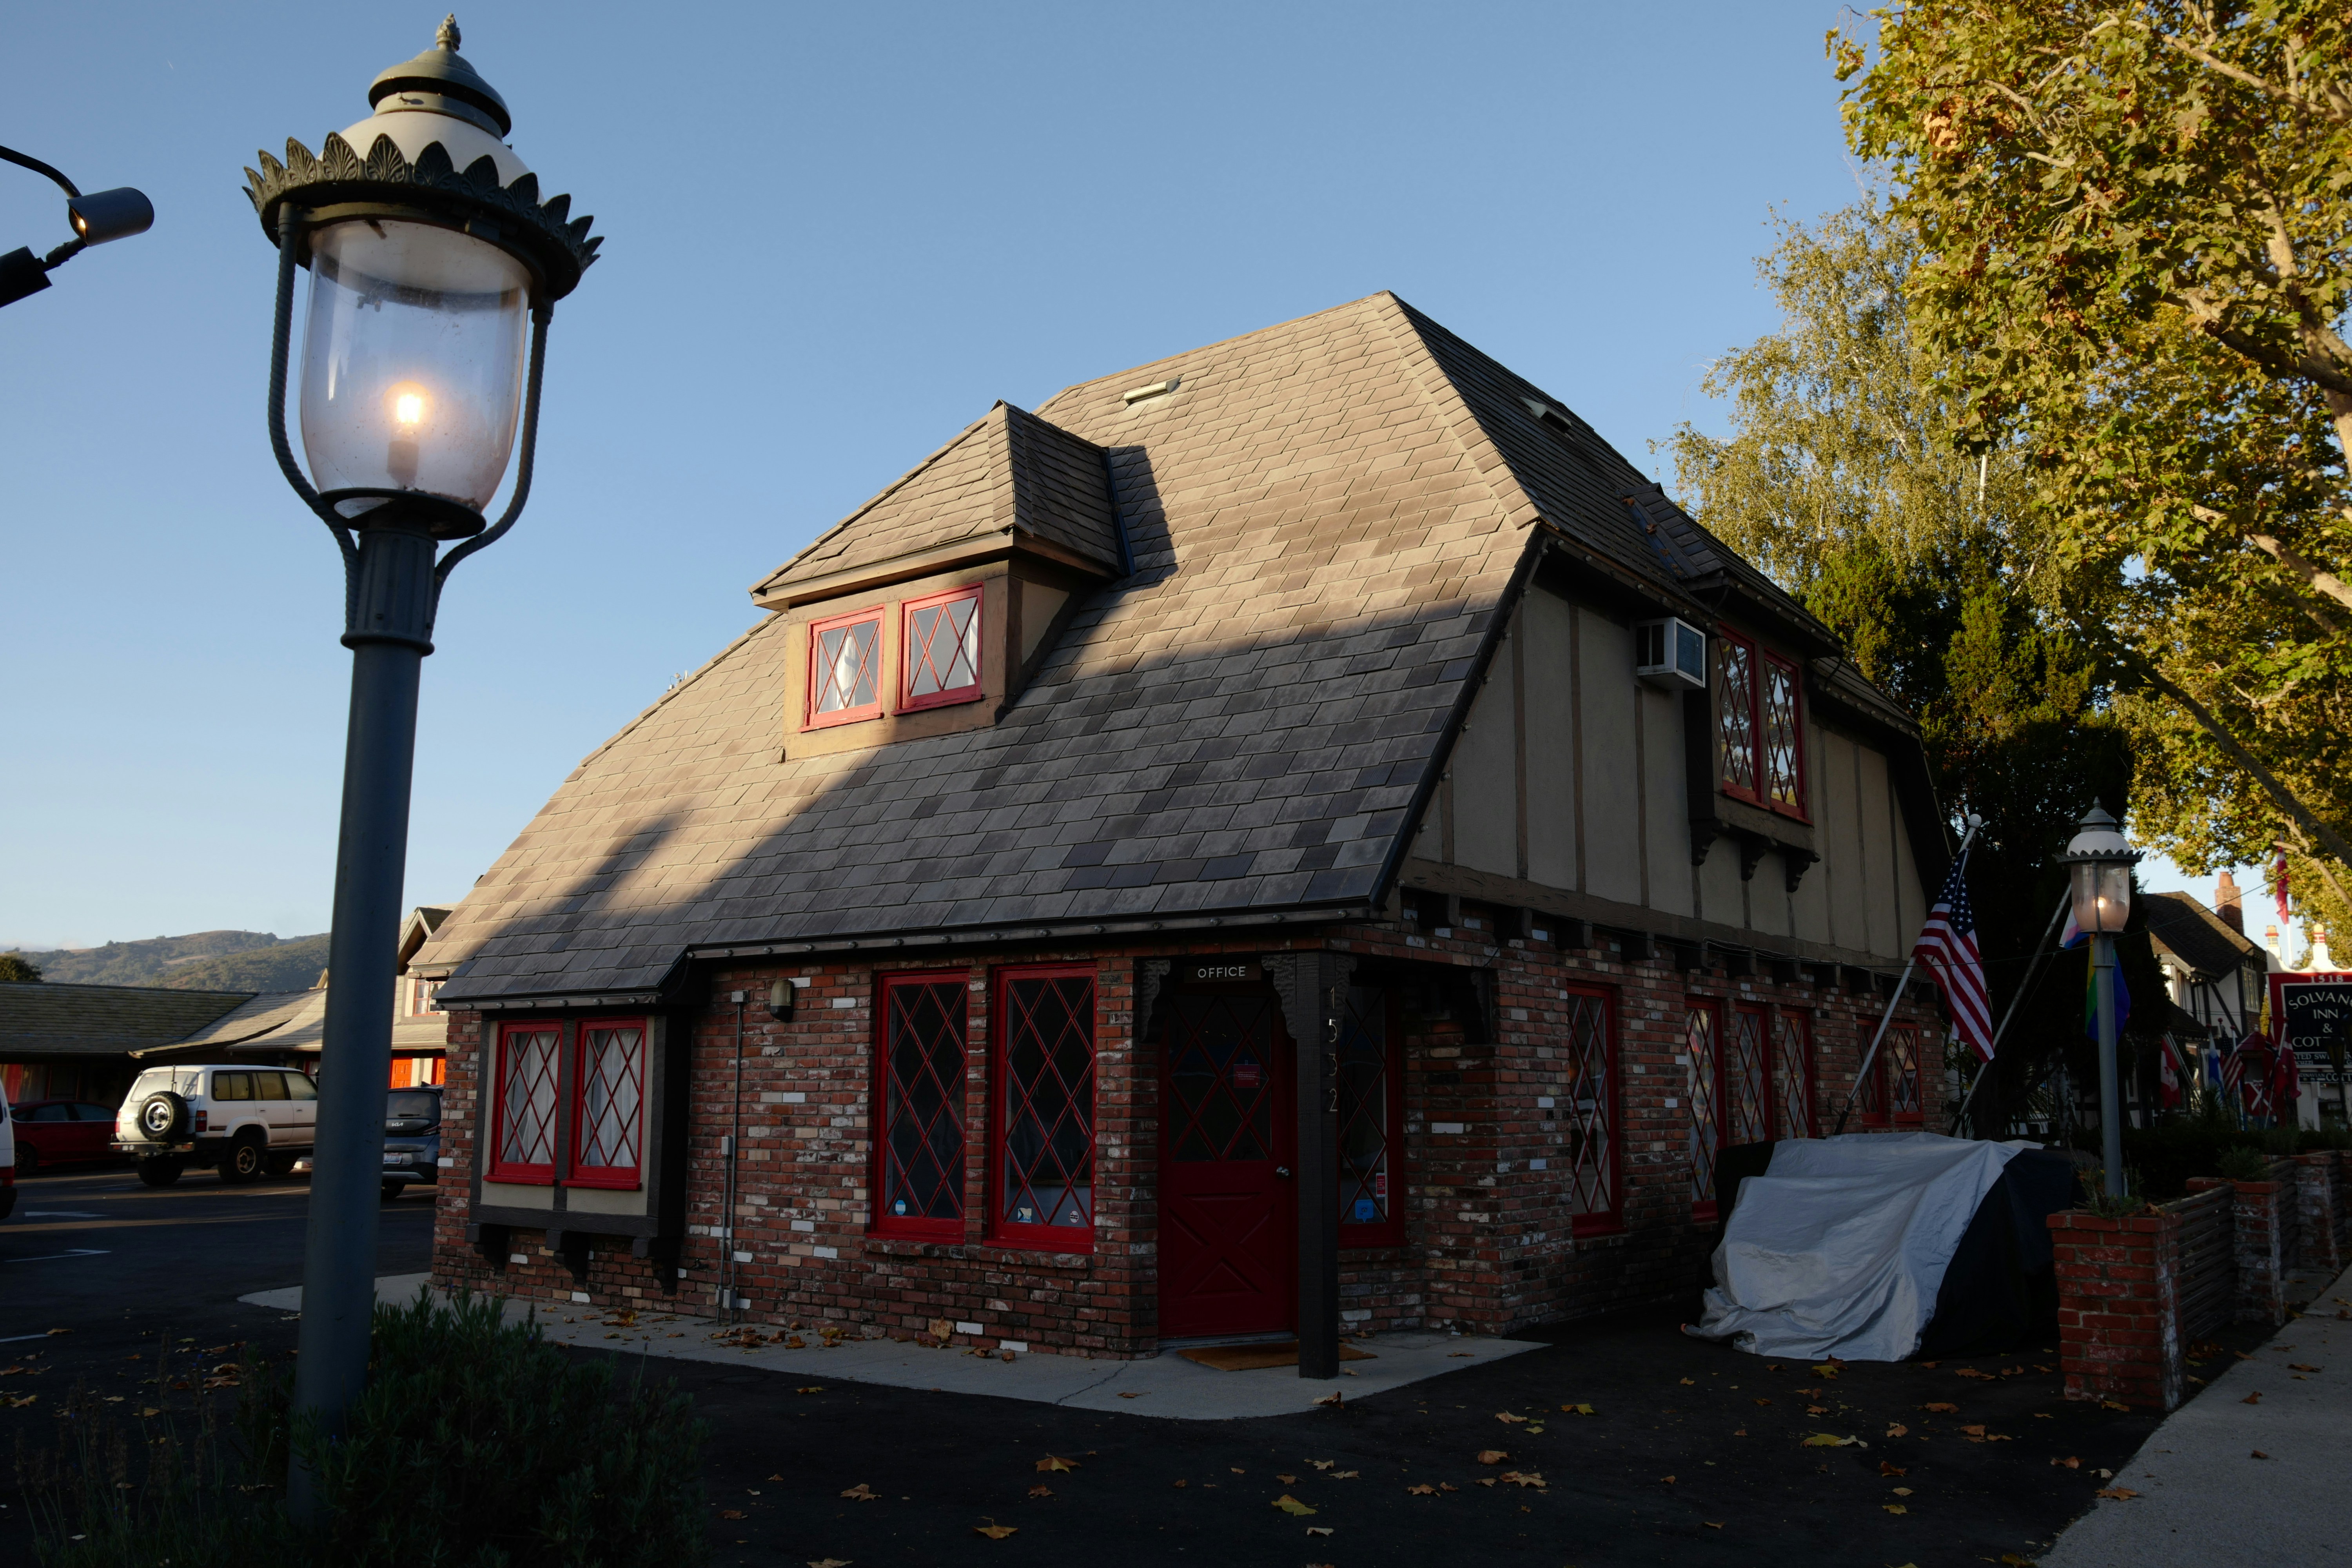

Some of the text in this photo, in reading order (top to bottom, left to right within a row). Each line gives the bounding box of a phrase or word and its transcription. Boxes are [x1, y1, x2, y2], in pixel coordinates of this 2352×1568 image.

[1198, 966, 1246, 978] OFFICE
[2310, 975, 2344, 983] 1518
[2313, 1008, 2339, 1019] INN
[2322, 1022, 2333, 1033] &
[1328, 985, 1338, 1112] 1532
